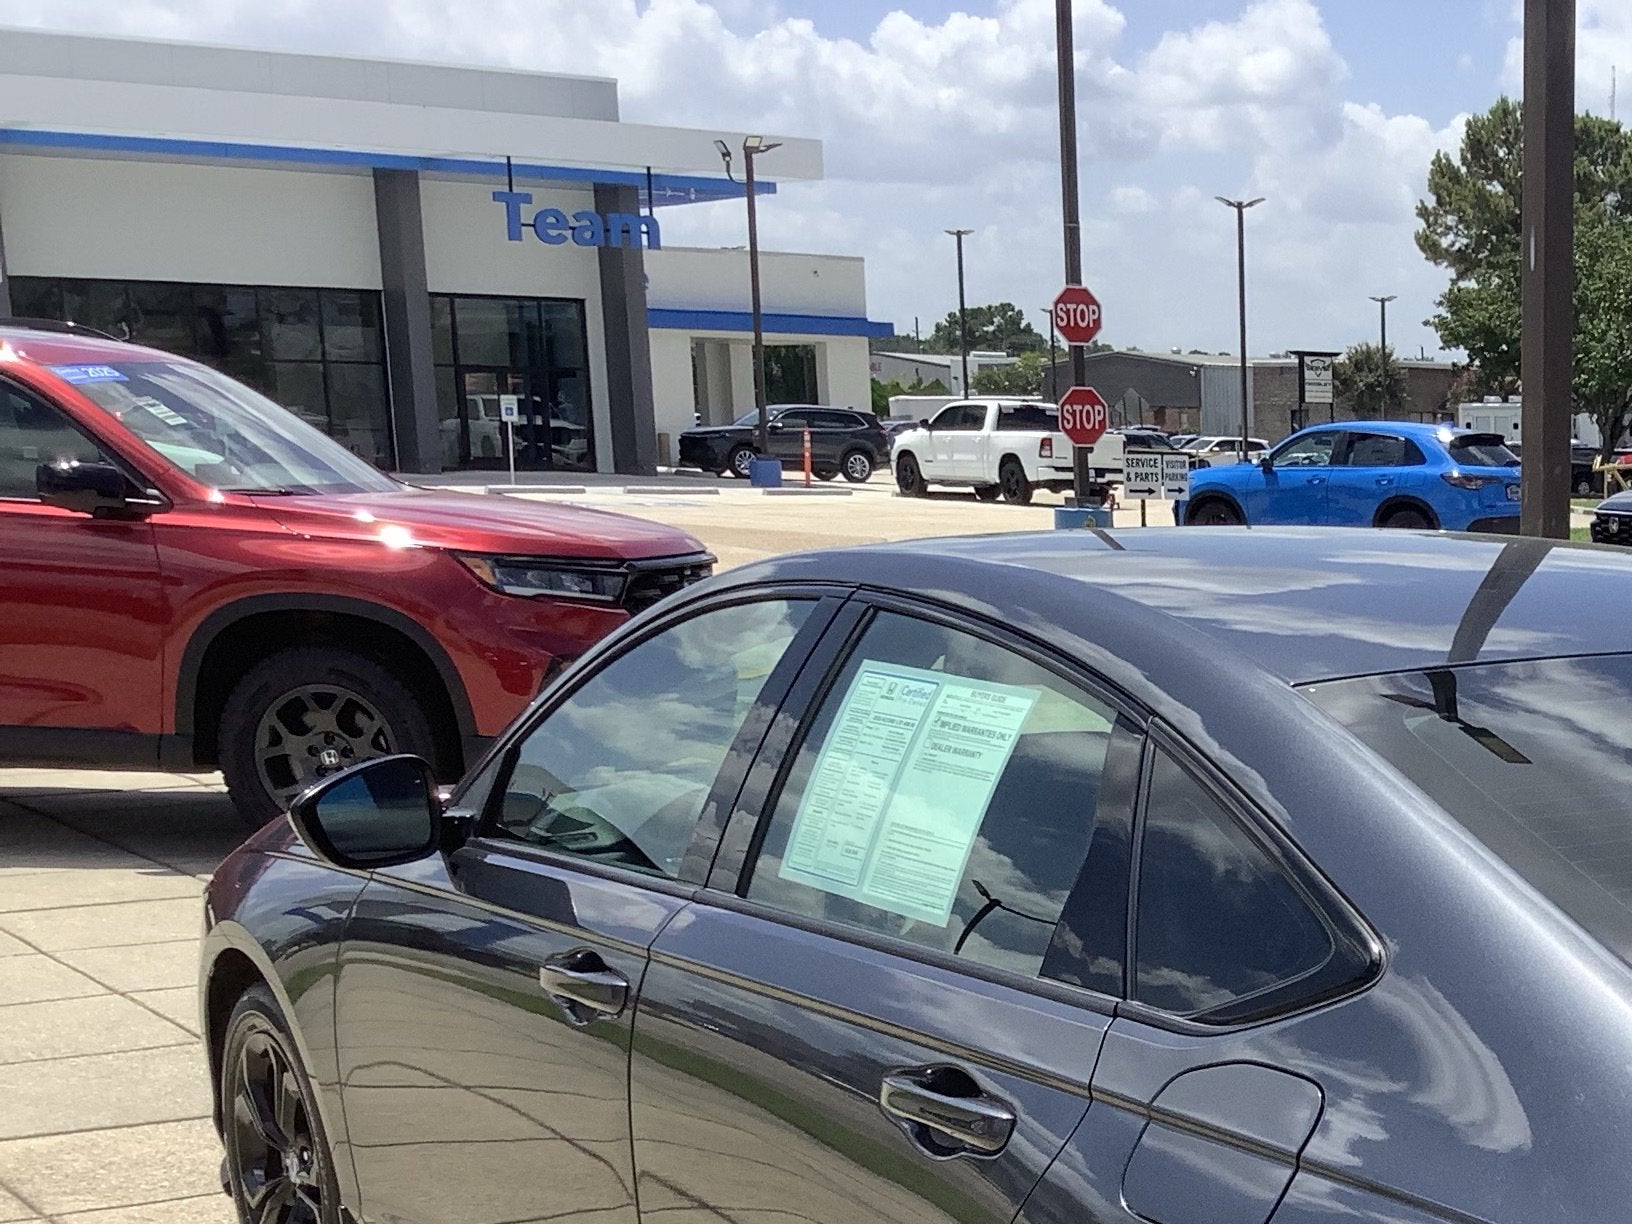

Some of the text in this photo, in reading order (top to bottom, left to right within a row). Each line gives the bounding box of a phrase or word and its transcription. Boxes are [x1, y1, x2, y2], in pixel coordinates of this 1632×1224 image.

[492, 191, 661, 250] Team
[1056, 303, 1099, 328] STOP
[1063, 404, 1104, 430] STOP
[1126, 458, 1159, 468] SERVICE
[1166, 460, 1187, 469] VISITOR
[1126, 472, 1159, 482] & PARTS
[1165, 473, 1188, 481] PARKING
[901, 685, 932, 700] Certified
[996, 732, 1013, 741] ONLY
